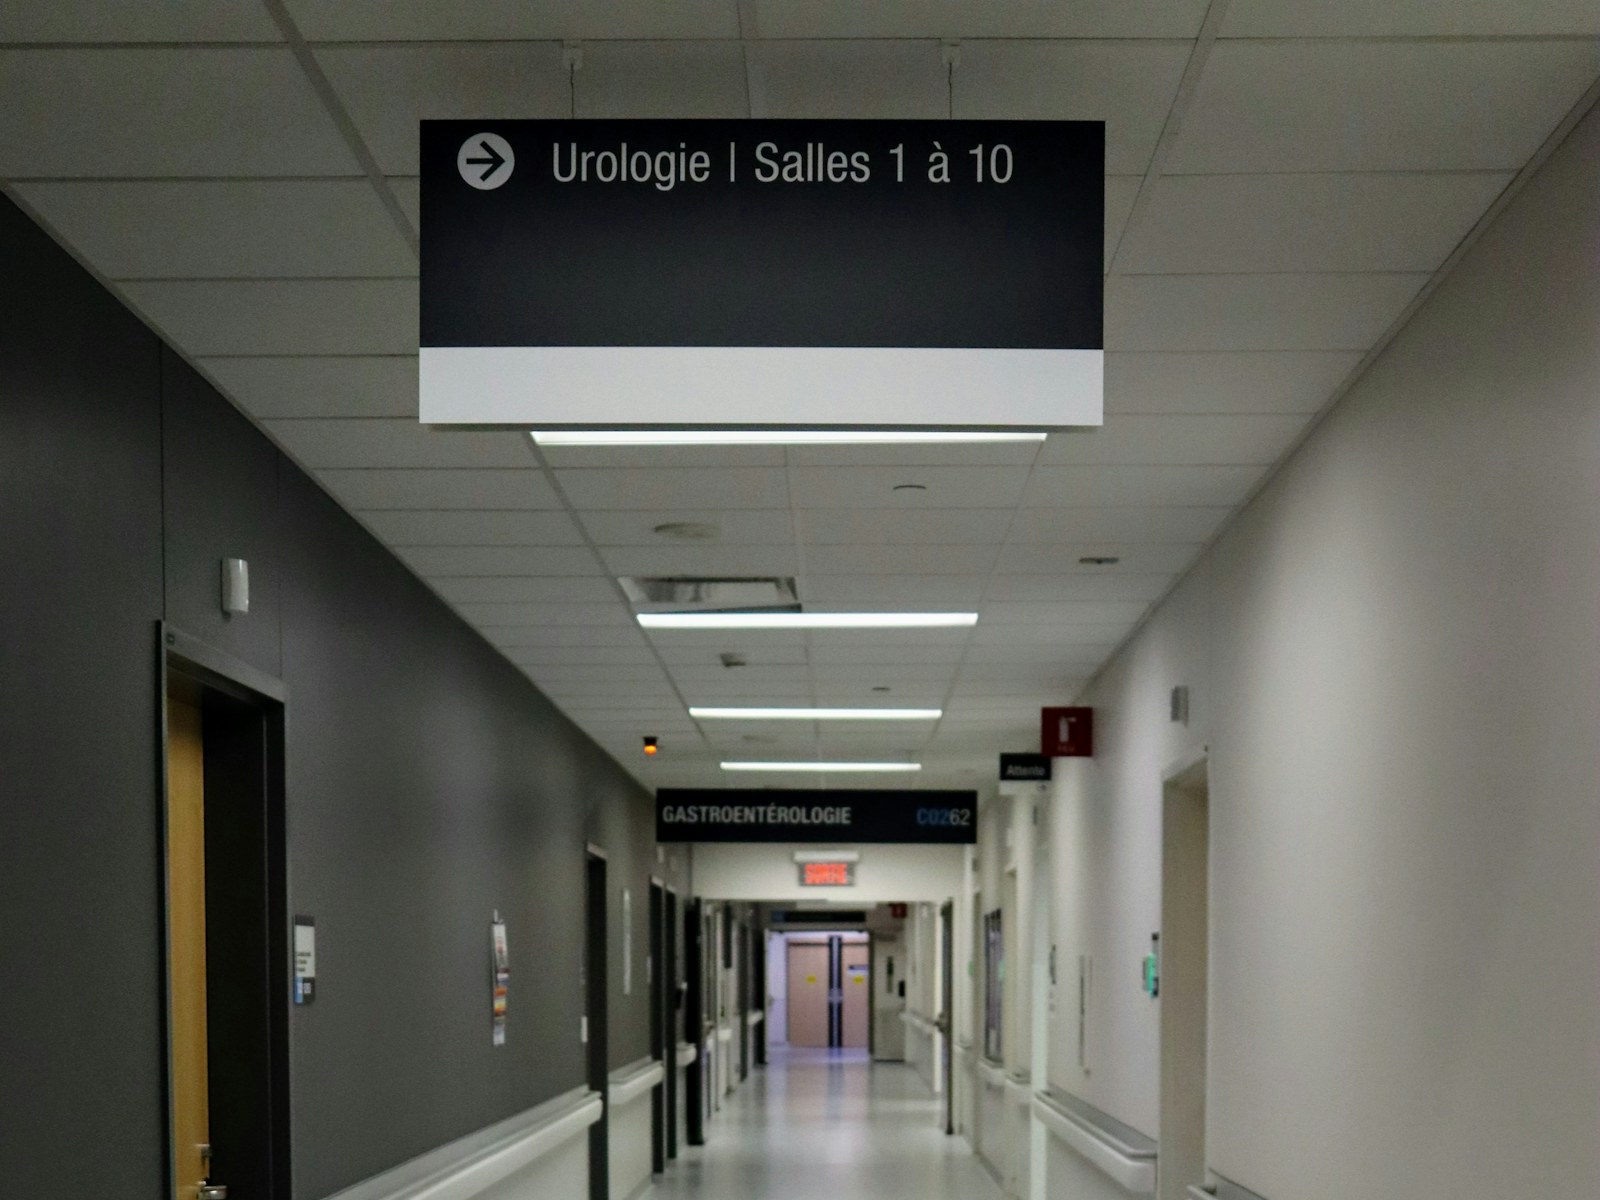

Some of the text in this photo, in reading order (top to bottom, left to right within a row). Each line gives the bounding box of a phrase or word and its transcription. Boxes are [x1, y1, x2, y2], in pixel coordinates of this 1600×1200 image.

[552, 142, 711, 192] Urologie
[754, 141, 871, 183] Salles
[889, 143, 904, 183] 1
[927, 140, 951, 184] à
[969, 143, 1014, 184] 10
[662, 803, 852, 825] GASTROENTÉROLOGIE
